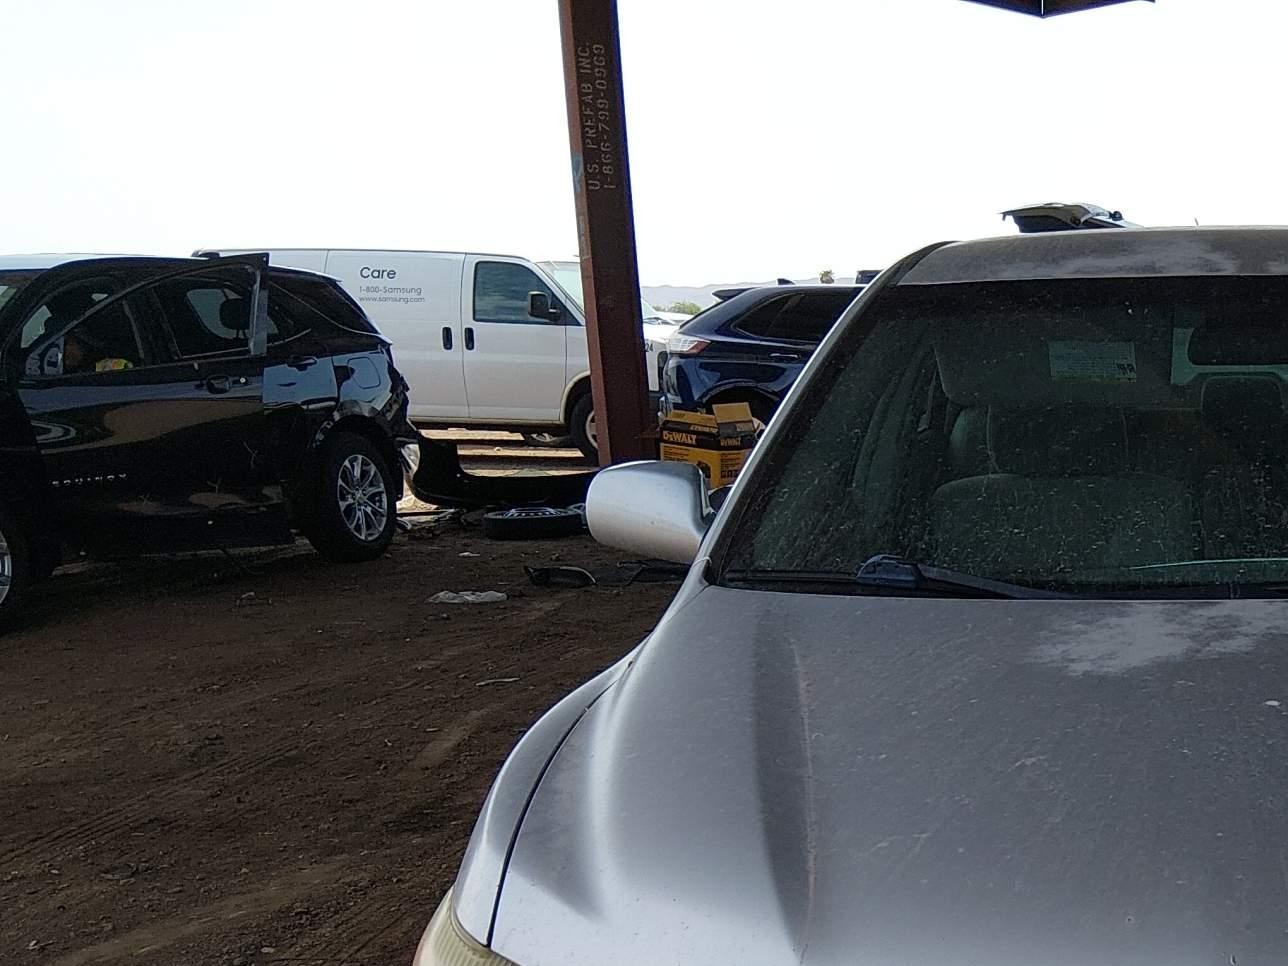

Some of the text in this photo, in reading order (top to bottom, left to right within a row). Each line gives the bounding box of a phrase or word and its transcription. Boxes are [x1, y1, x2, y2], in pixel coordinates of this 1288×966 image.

[577, 42, 601, 190] U.S. PREFAB INC.
[360, 266, 397, 280] Care
[359, 286, 422, 296] 1-800-Samsung
[358, 296, 426, 305] www.samsung.com
